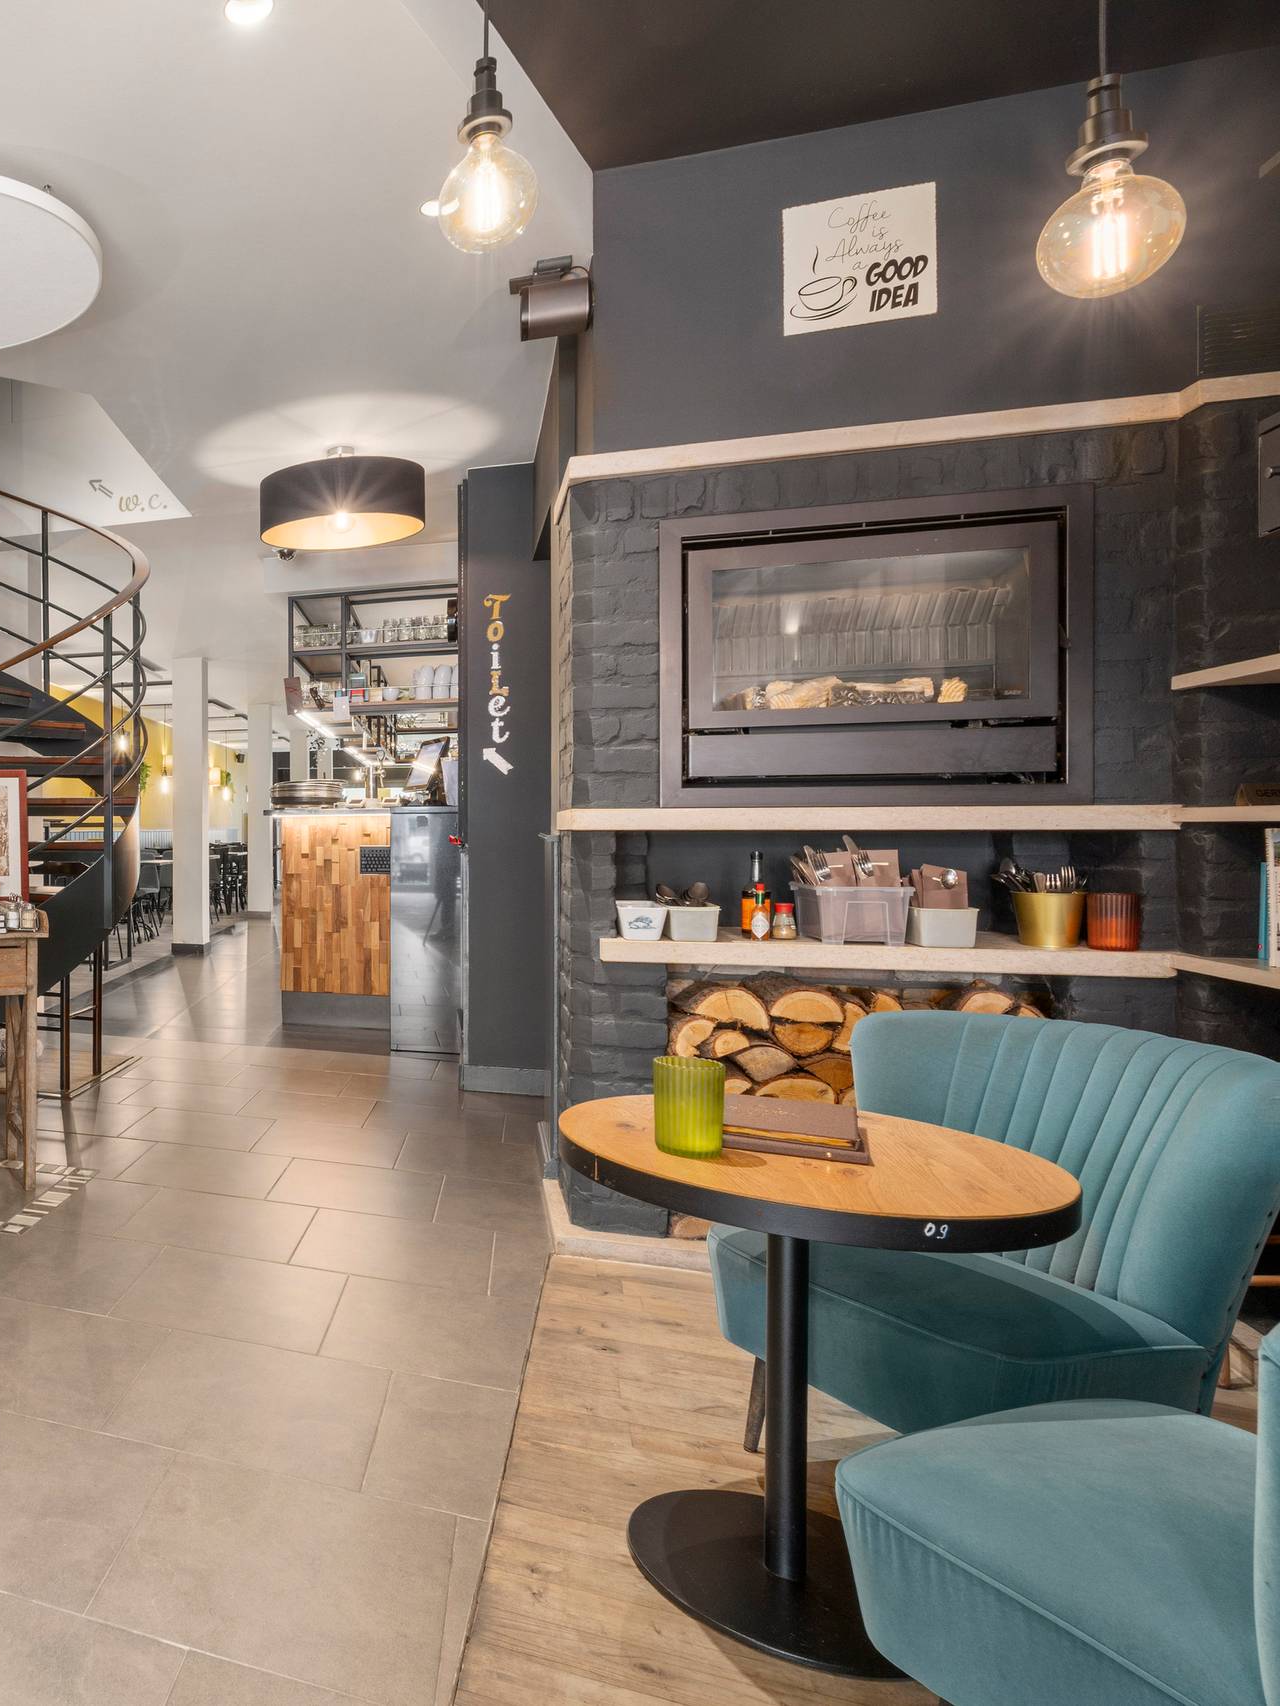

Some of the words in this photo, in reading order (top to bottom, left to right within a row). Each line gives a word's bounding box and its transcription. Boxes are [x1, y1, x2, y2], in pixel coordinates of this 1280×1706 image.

[828, 200, 891, 232] Coffee
[872, 226, 888, 240] is
[825, 236, 903, 261] Always
[852, 260, 869, 271] a
[865, 255, 928, 286] GOOD
[870, 282, 919, 312] IDEA
[924, 1222, 948, 1239] 09
